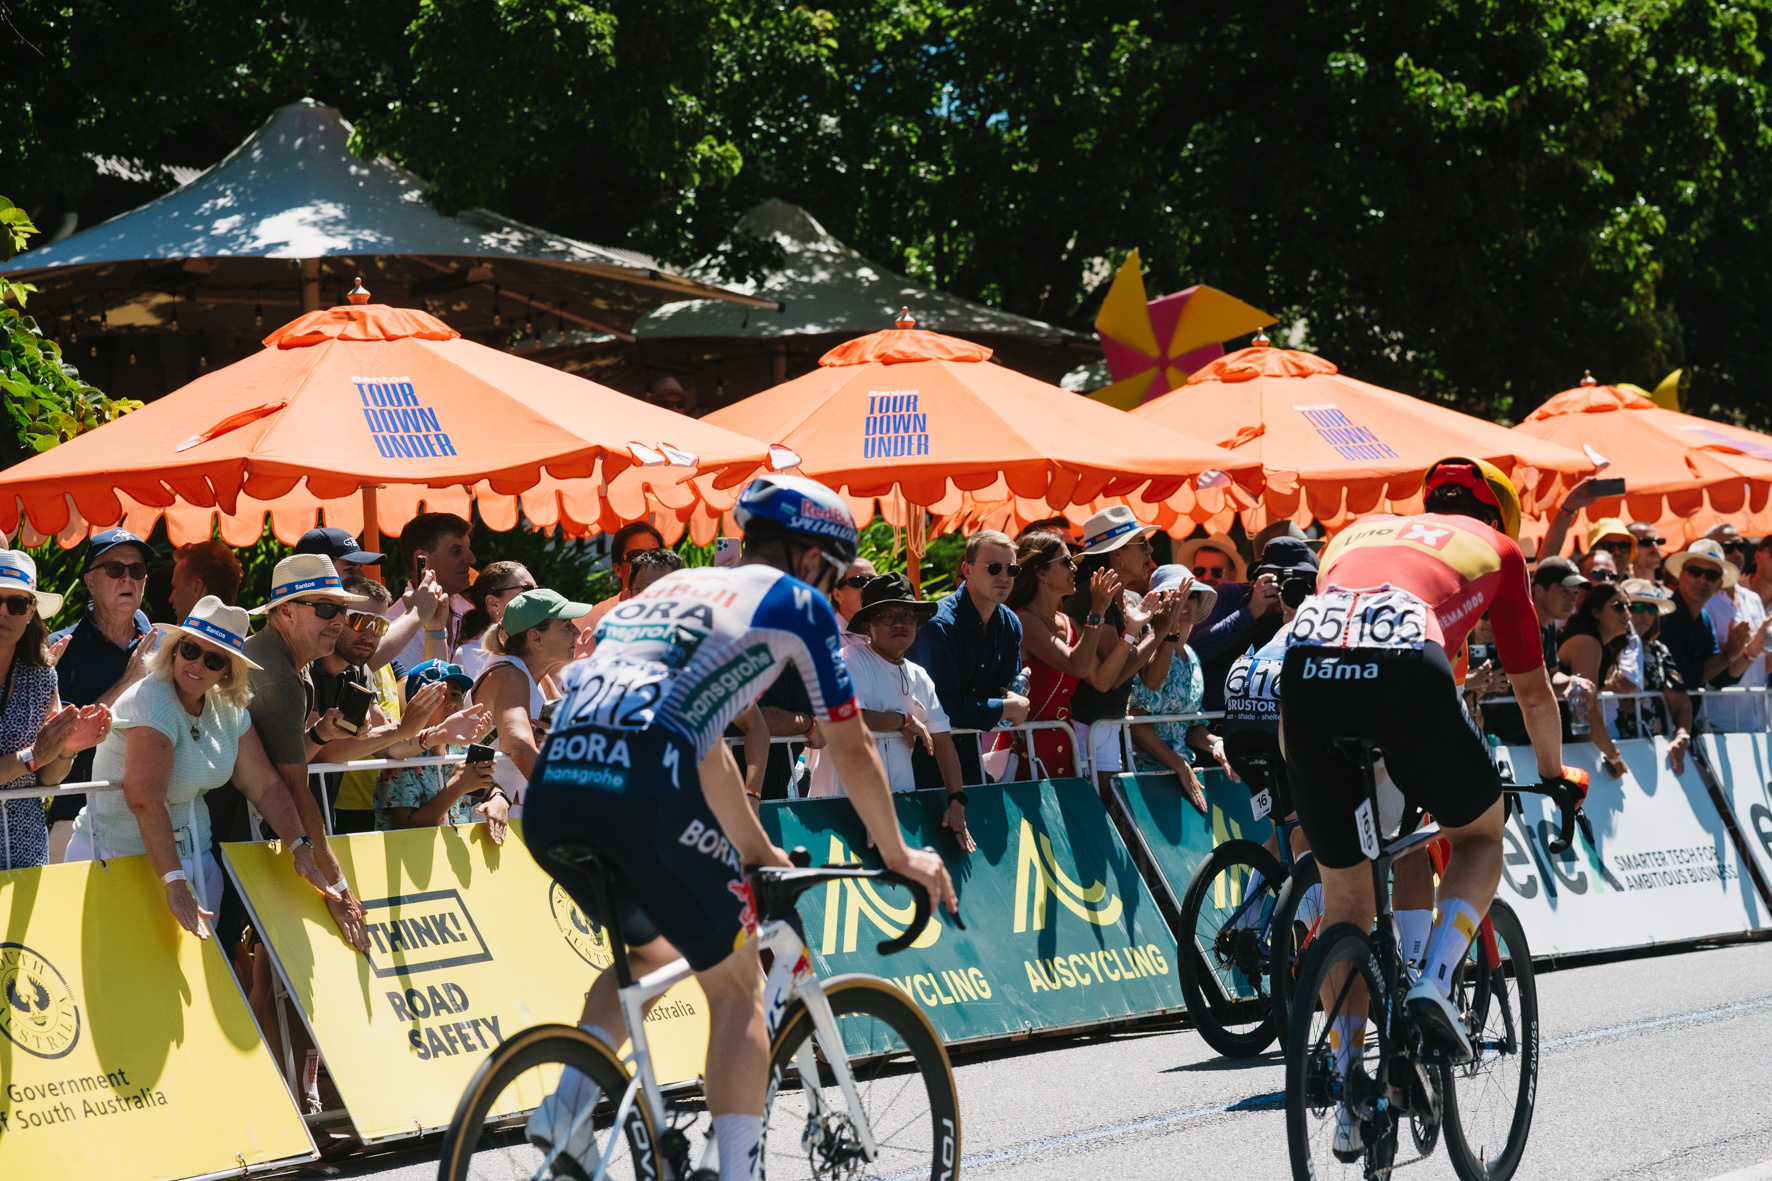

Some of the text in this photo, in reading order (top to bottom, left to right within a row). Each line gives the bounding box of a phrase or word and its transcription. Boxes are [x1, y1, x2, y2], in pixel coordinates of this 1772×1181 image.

[353, 382, 420, 408] TOUR
[868, 395, 918, 415] TOUR
[363, 407, 442, 434] DOWN
[865, 413, 927, 436] DOWN
[1299, 408, 1353, 428] TOUR
[373, 433, 457, 459] UNDER
[864, 434, 929, 458] UNDER
[1316, 425, 1379, 445] DOWN
[1333, 443, 1400, 461] UNDER
[1344, 528, 1394, 547] Uno
[294, 581, 316, 591] Santos
[615, 601, 713, 630] ORA
[1353, 605, 1423, 644] 165
[205, 625, 226, 639] Santos
[680, 651, 771, 726] hansgrohe
[1226, 699, 1277, 713] BRUSTOR
[546, 733, 631, 769] BORA
[543, 765, 625, 788] hansgrohe
[1256, 794, 1268, 809] 16
[1360, 806, 1376, 851] 165
[678, 818, 740, 873] BORA
[1614, 845, 1721, 871] SMARTER TECH FOR
[1625, 863, 1738, 891] AMBITIOUS BUSINESS
[366, 912, 468, 954] THINK!
[1023, 943, 1169, 993] AUSCYCLING
[884, 966, 992, 1007] YCLING
[385, 982, 470, 1022] ROAD
[645, 1000, 696, 1022] ustralia
[407, 1015, 505, 1060] SAFETY
[7, 1068, 130, 1103] Government
[15, 1101, 77, 1130] South
[82, 1087, 168, 1119] Australia
